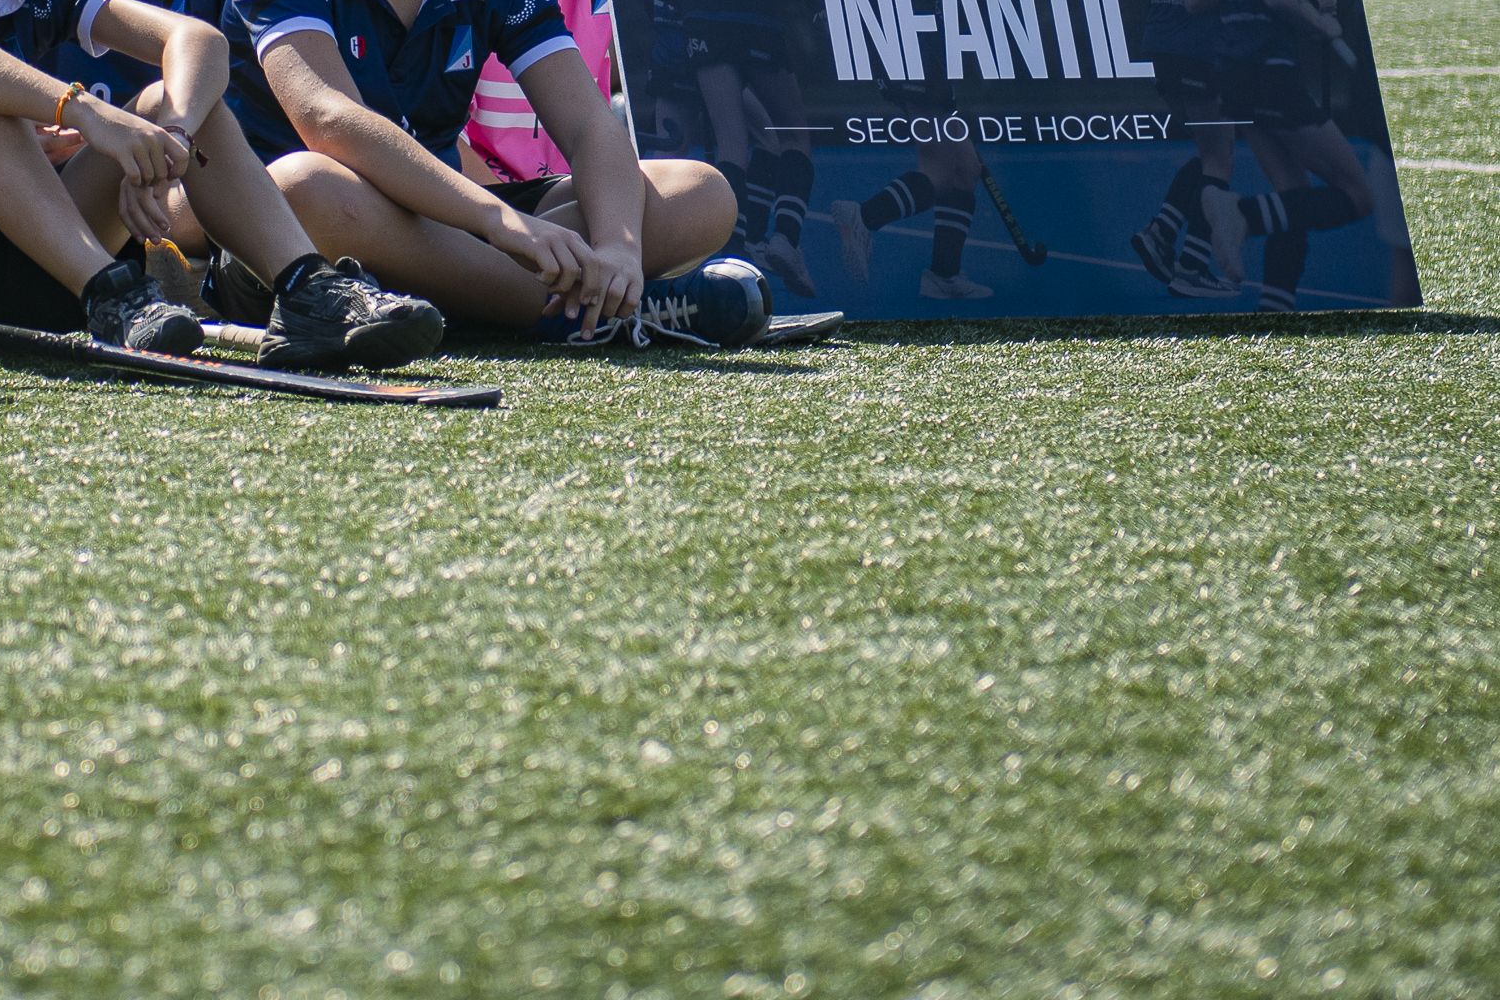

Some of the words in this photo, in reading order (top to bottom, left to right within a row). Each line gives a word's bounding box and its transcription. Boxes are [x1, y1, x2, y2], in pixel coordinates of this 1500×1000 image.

[846, 110, 970, 143] SECCIÓ
[978, 116, 1026, 142] DE
[1034, 114, 1172, 141] HOCKEY
